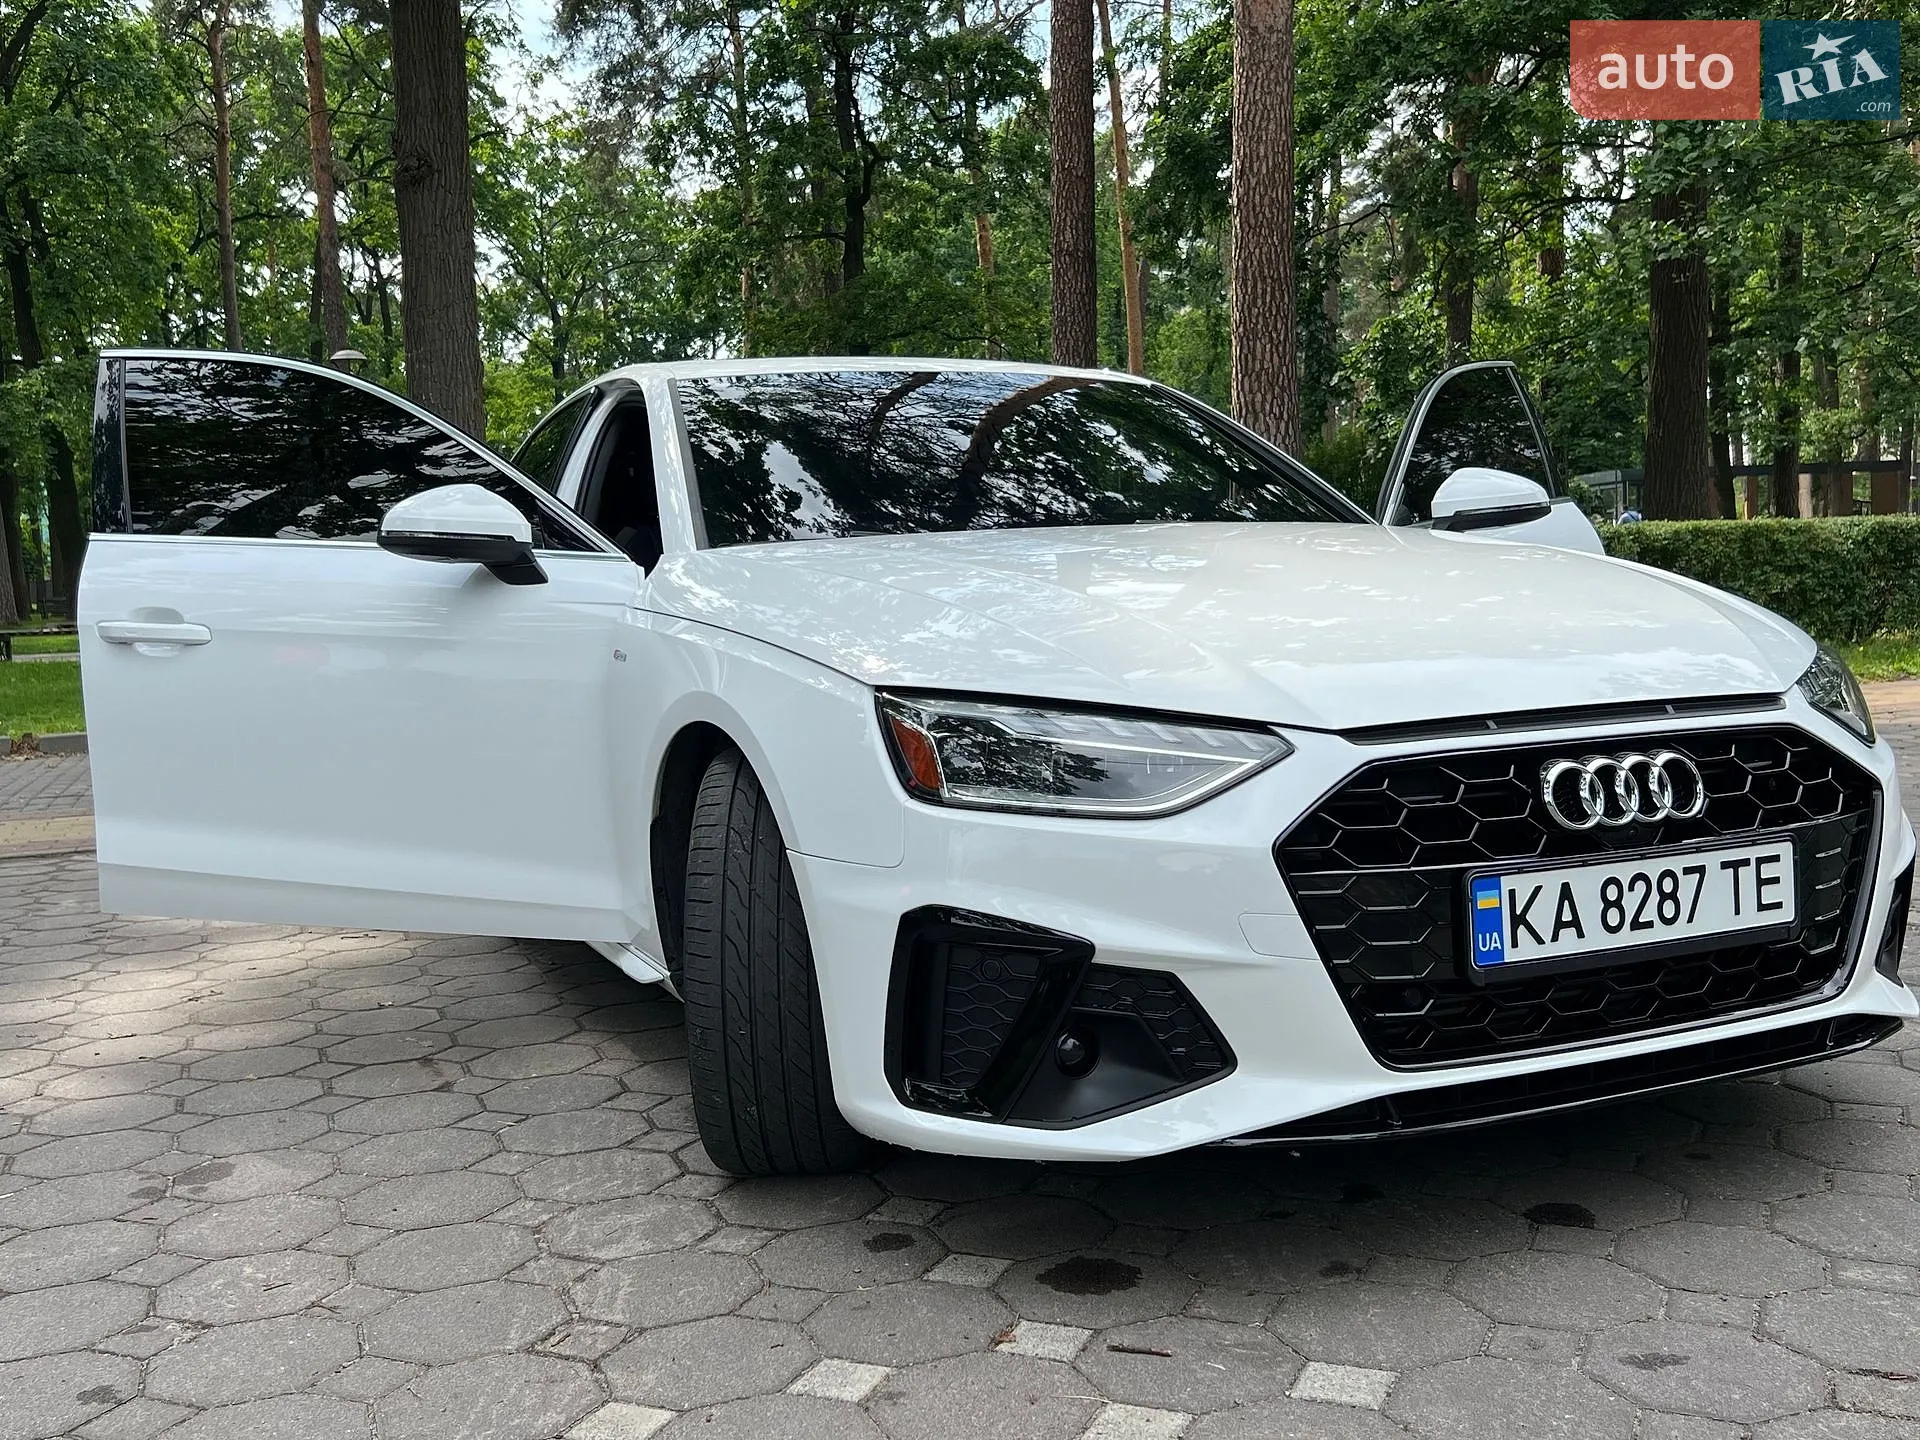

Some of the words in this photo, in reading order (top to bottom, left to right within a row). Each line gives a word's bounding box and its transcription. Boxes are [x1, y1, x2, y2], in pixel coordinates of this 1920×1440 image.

[1508, 881, 1586, 949] KA
[1600, 864, 1707, 934] 8287
[1720, 854, 1784, 916] TE
[1478, 931, 1502, 952] UA
